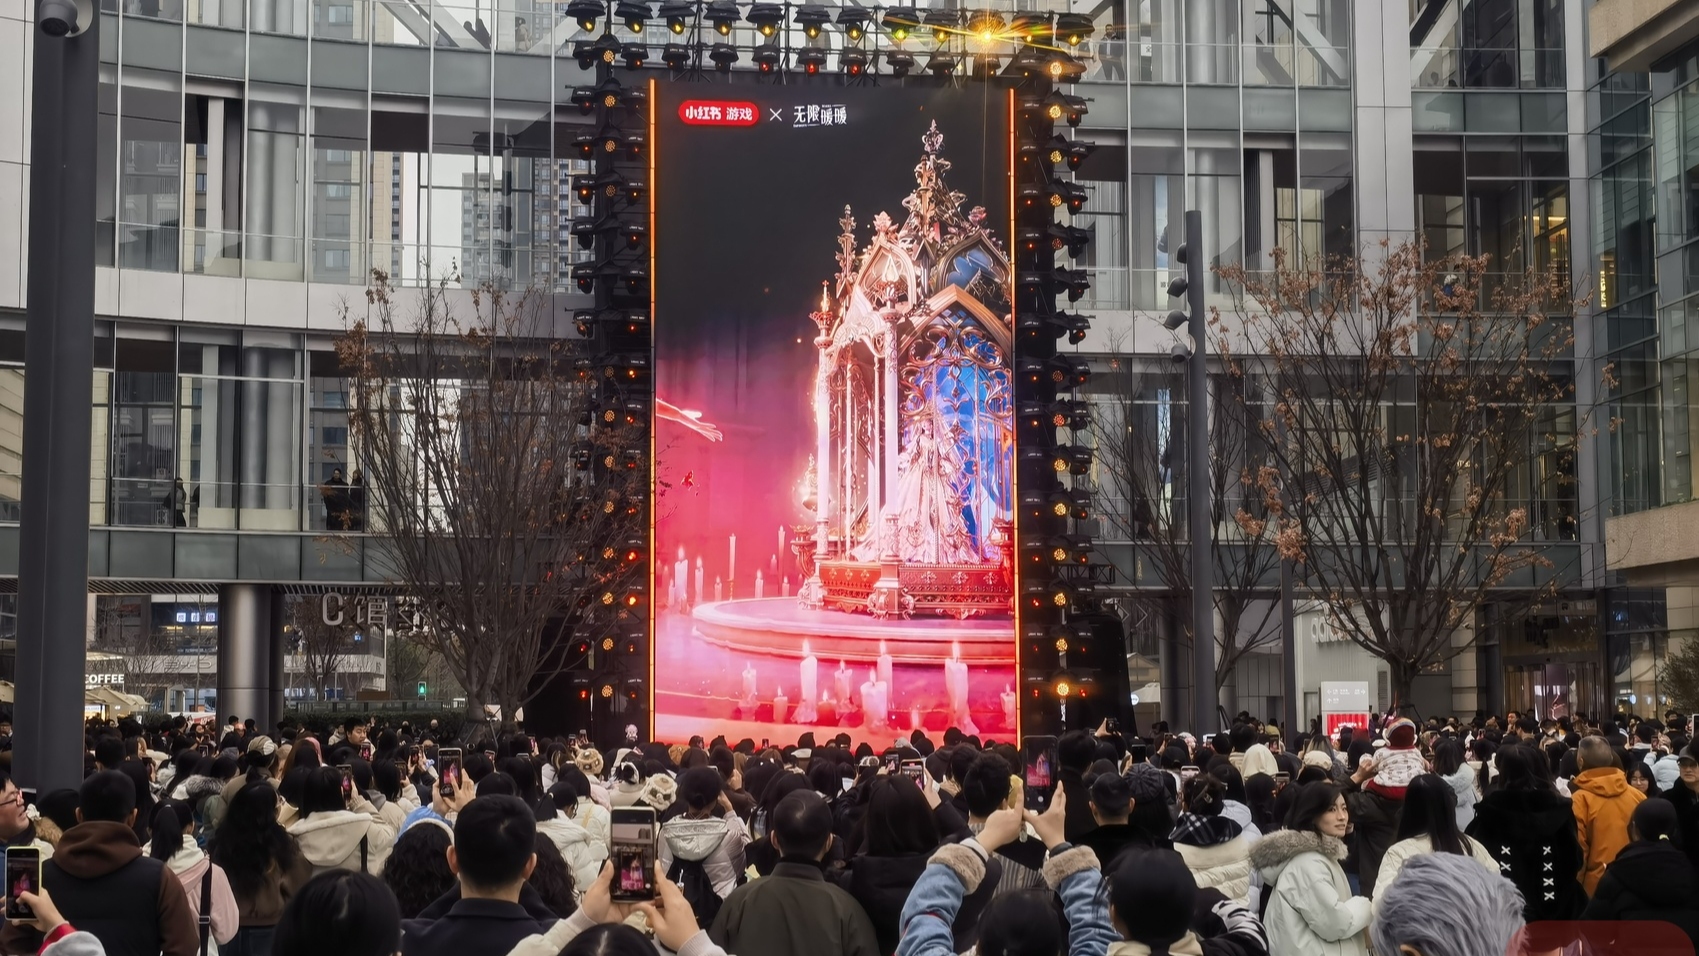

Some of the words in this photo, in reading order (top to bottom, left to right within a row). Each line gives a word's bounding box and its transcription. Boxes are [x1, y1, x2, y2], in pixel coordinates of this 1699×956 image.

[685, 106, 722, 120] 小红书
[726, 107, 753, 121] 游戏
[793, 104, 847, 126] 无限暖暖
[85, 673, 125, 684] COFFEE
